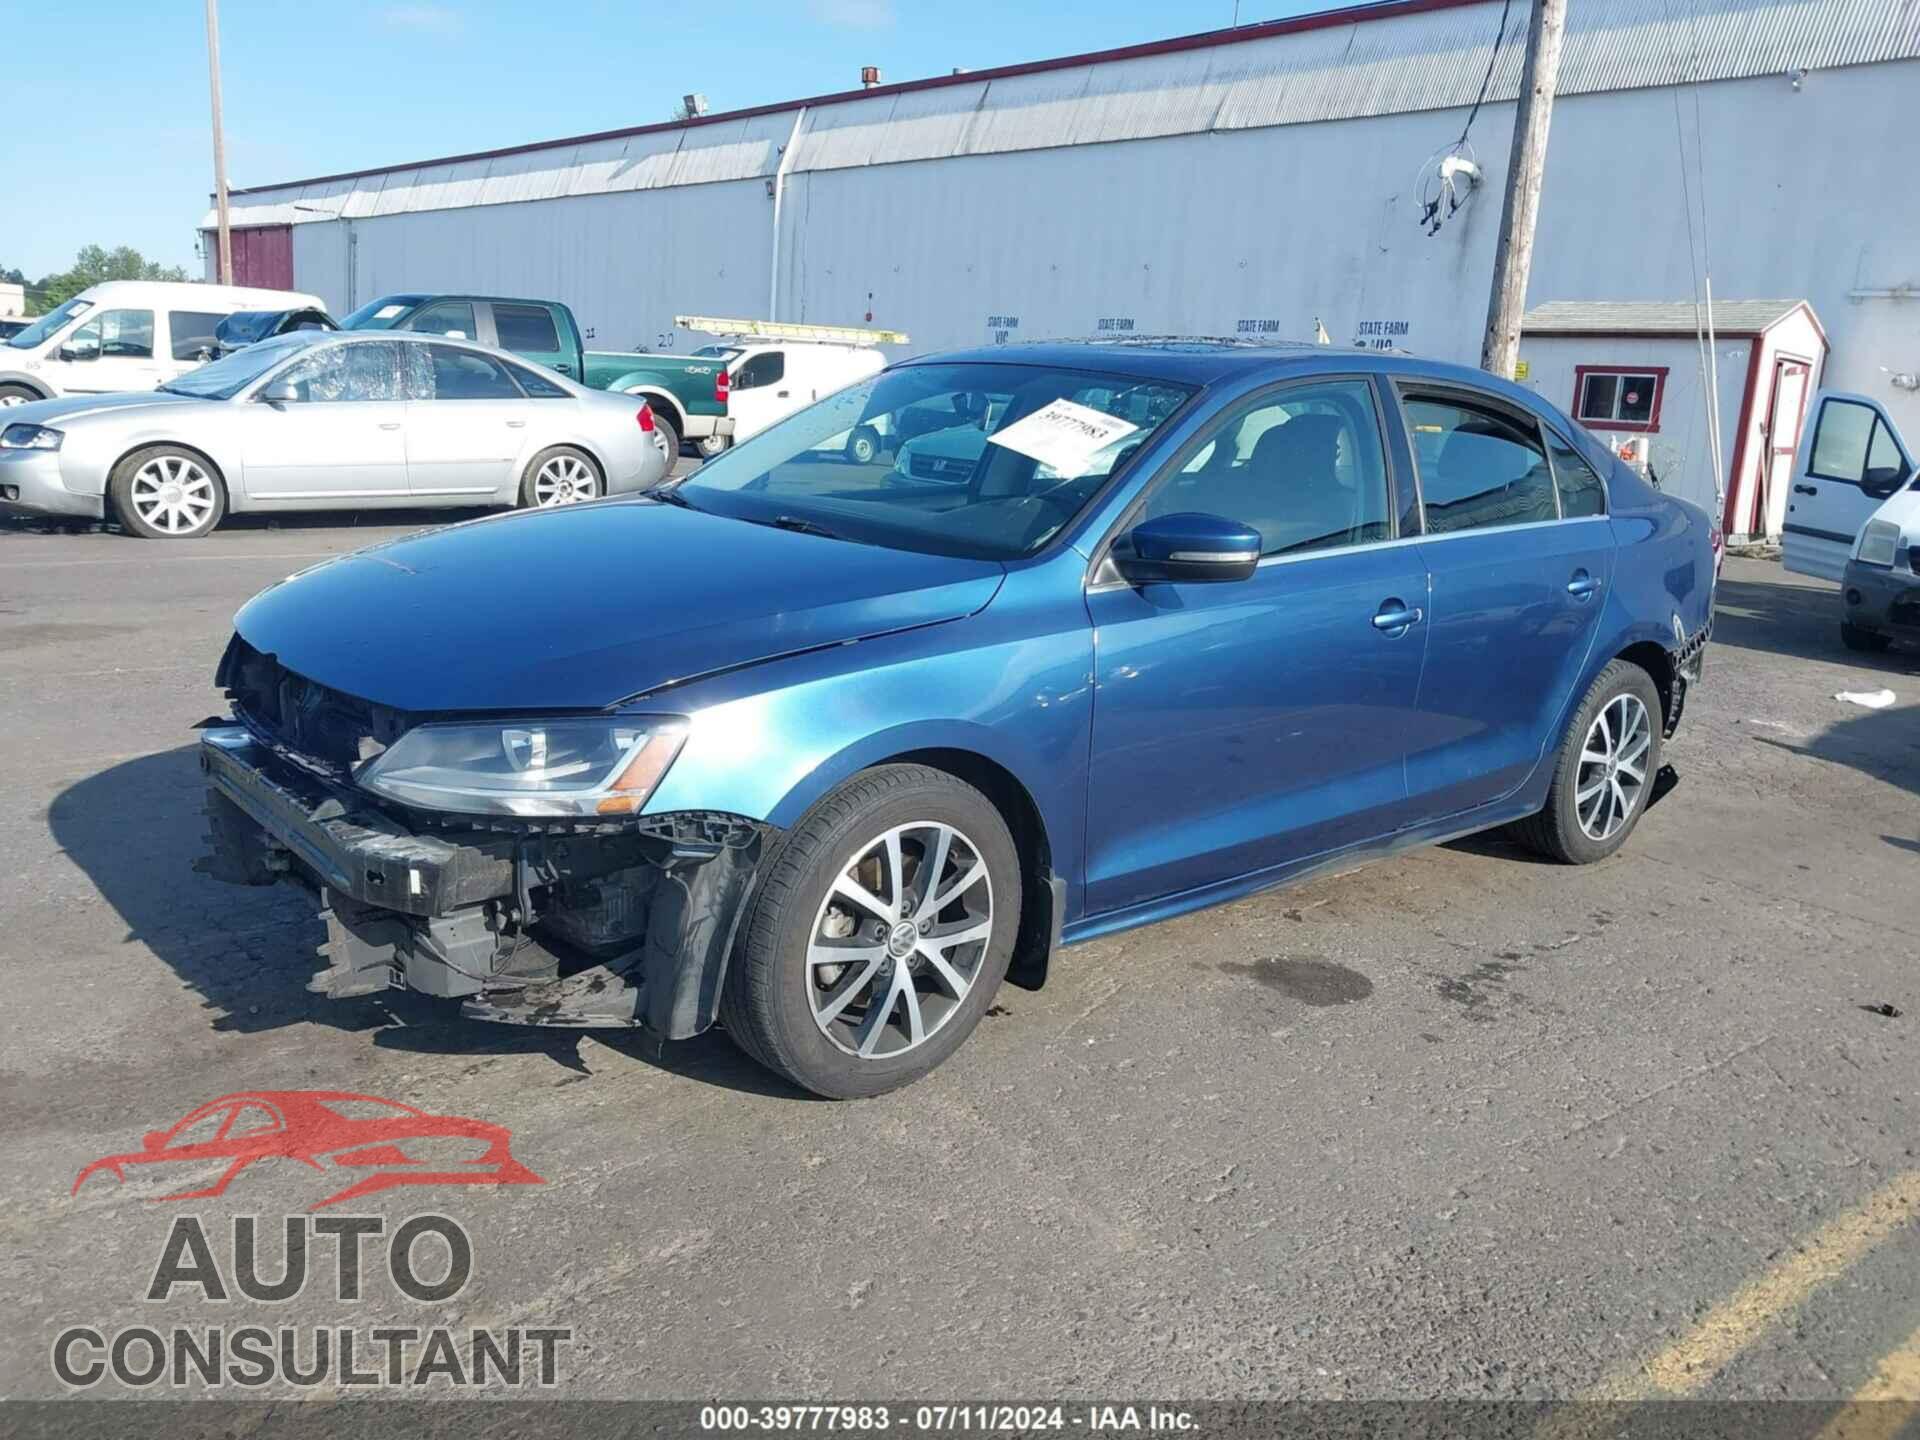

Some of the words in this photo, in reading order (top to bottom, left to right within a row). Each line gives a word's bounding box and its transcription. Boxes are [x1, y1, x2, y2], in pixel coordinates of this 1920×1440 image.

[1237, 319, 1257, 333] STATE
[1258, 319, 1280, 333] FARM
[1359, 321, 1383, 336] STATE
[1384, 321, 1409, 336] FARM
